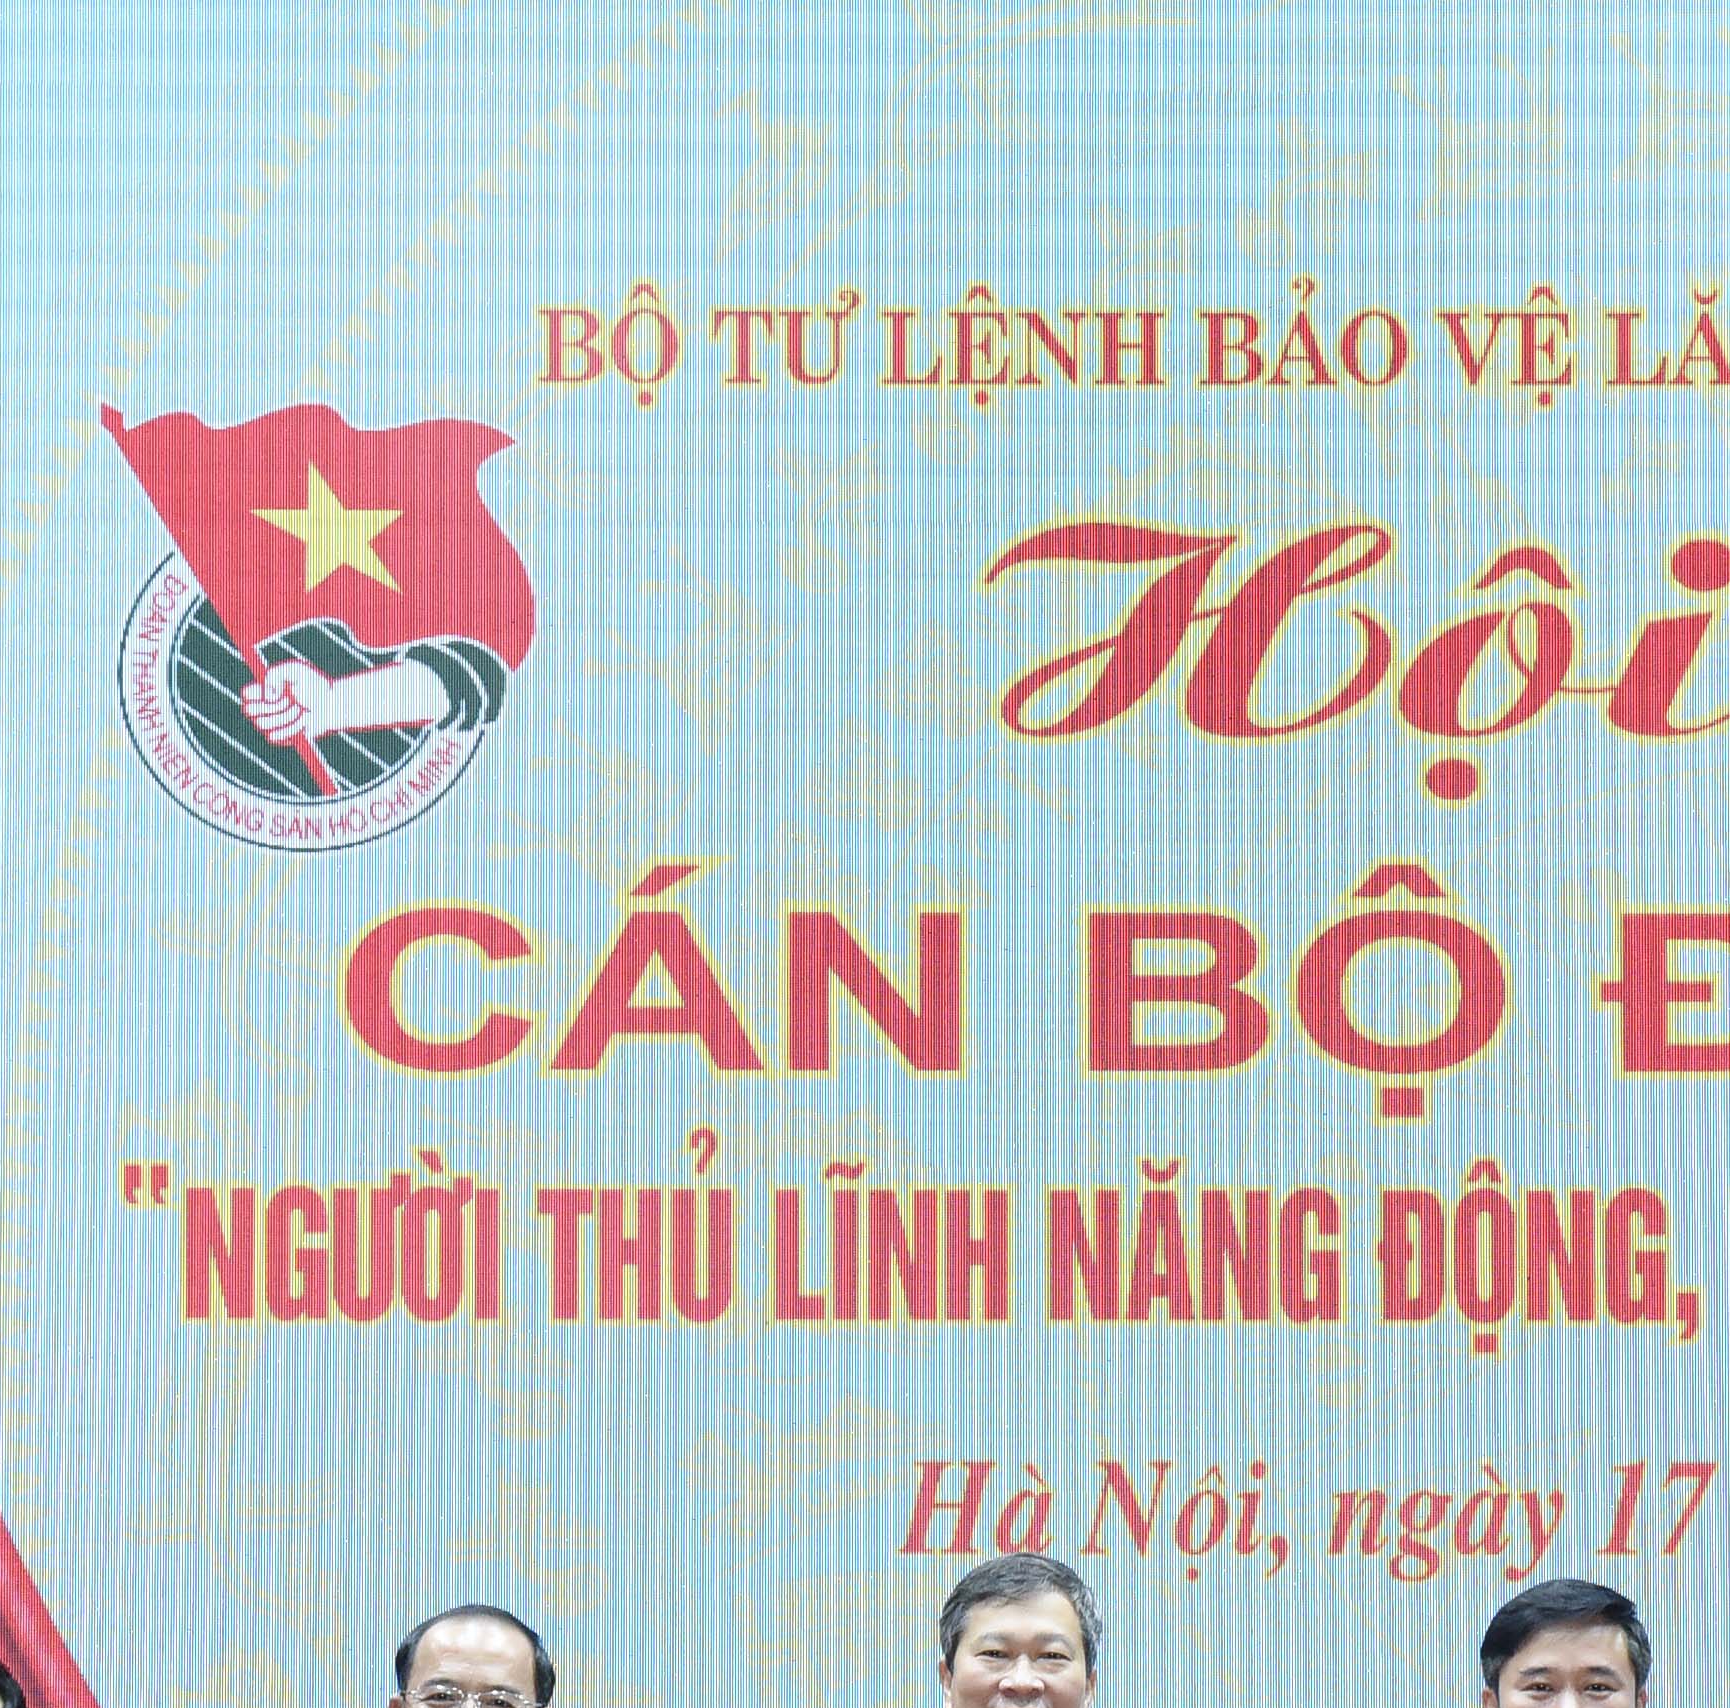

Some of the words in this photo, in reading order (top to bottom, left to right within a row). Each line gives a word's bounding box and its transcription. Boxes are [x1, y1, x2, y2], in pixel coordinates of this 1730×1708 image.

[538, 284, 679, 406] BỘ
[713, 289, 859, 385] TƯ
[881, 285, 1165, 405] LỆNH
[1199, 277, 1409, 386] BẢO
[1438, 285, 1572, 406] VỆ
[132, 649, 165, 733] THANH
[408, 738, 462, 797] MINH
[344, 863, 963, 1075] CÁN
[1087, 863, 1508, 1119] BỘ
[537, 1128, 733, 1324] THỦ
[774, 1161, 1010, 1322] LĨNH
[1050, 1160, 1341, 1324] NĂNG
[1376, 1160, 1700, 1354] ĐỘNG,
[898, 1459, 1054, 1554] Hà
[1080, 1459, 1290, 1581] Nội,
[1329, 1490, 1565, 1582] ngày
[1595, 1461, 1719, 1555] 17
